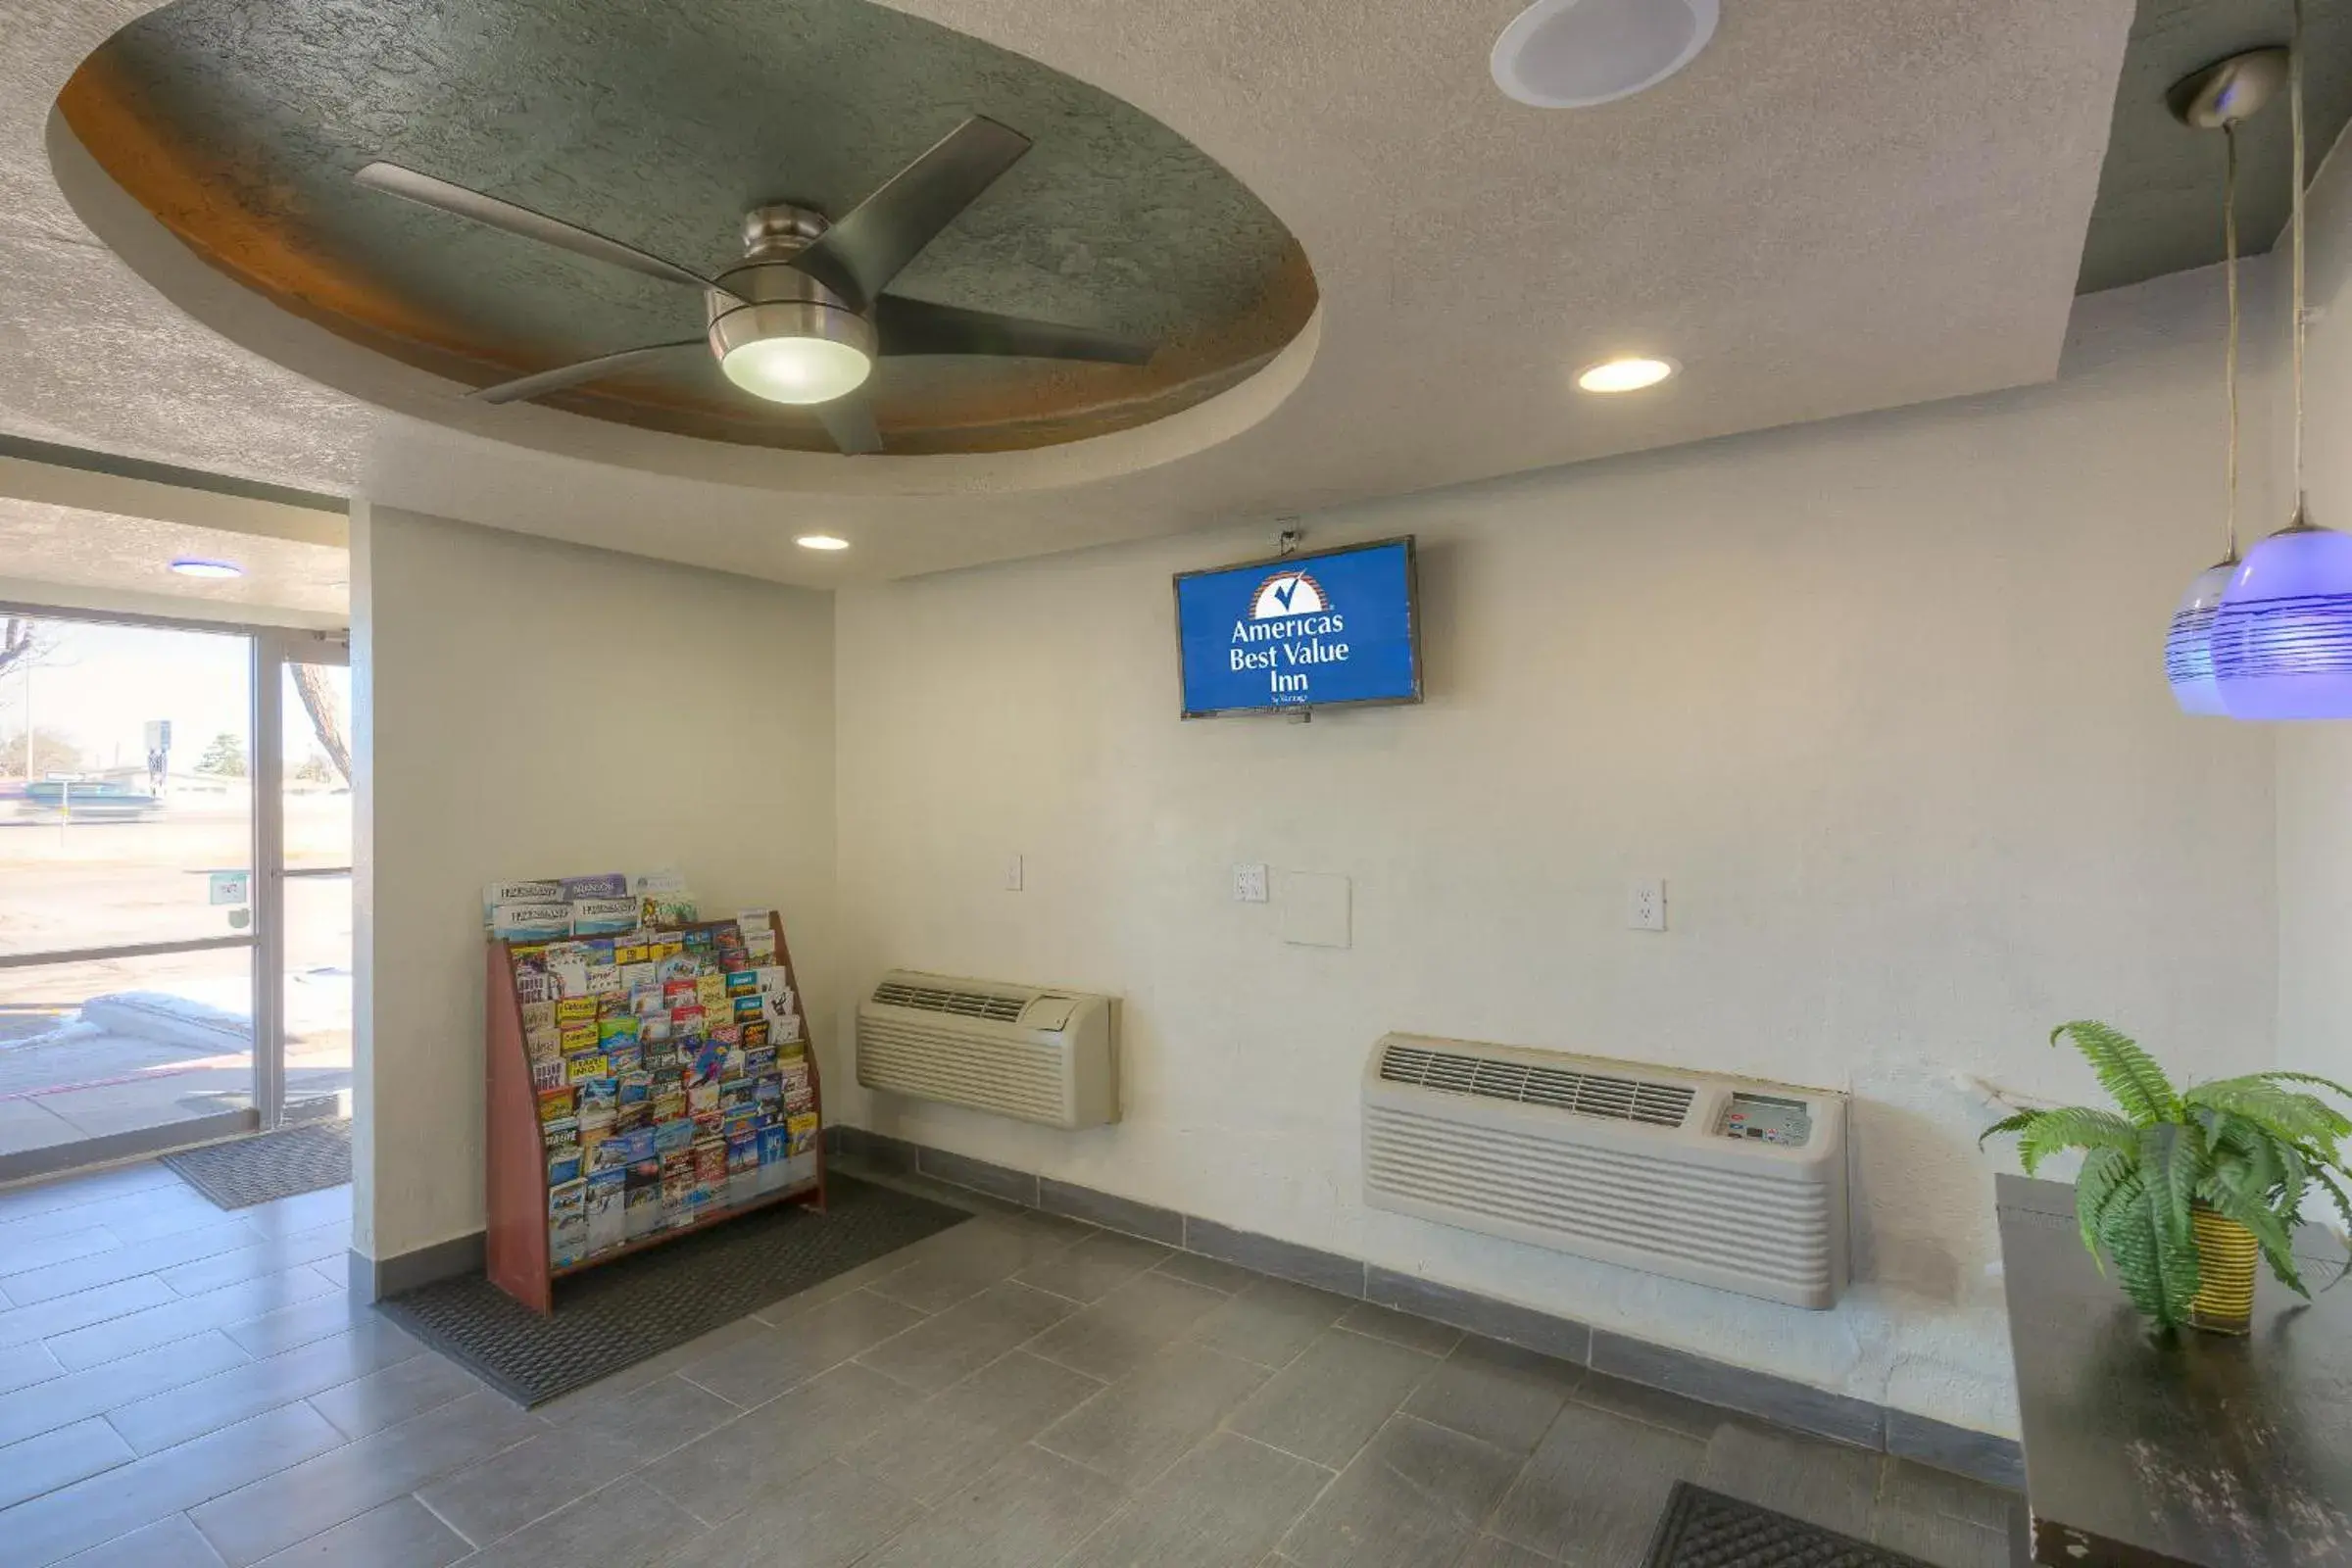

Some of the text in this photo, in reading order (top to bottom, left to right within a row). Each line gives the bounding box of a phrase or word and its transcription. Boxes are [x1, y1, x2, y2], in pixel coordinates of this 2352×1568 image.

[1232, 614, 1344, 644] Americas
[1230, 638, 1349, 671] Best Value
[1270, 670, 1309, 693] Inn
